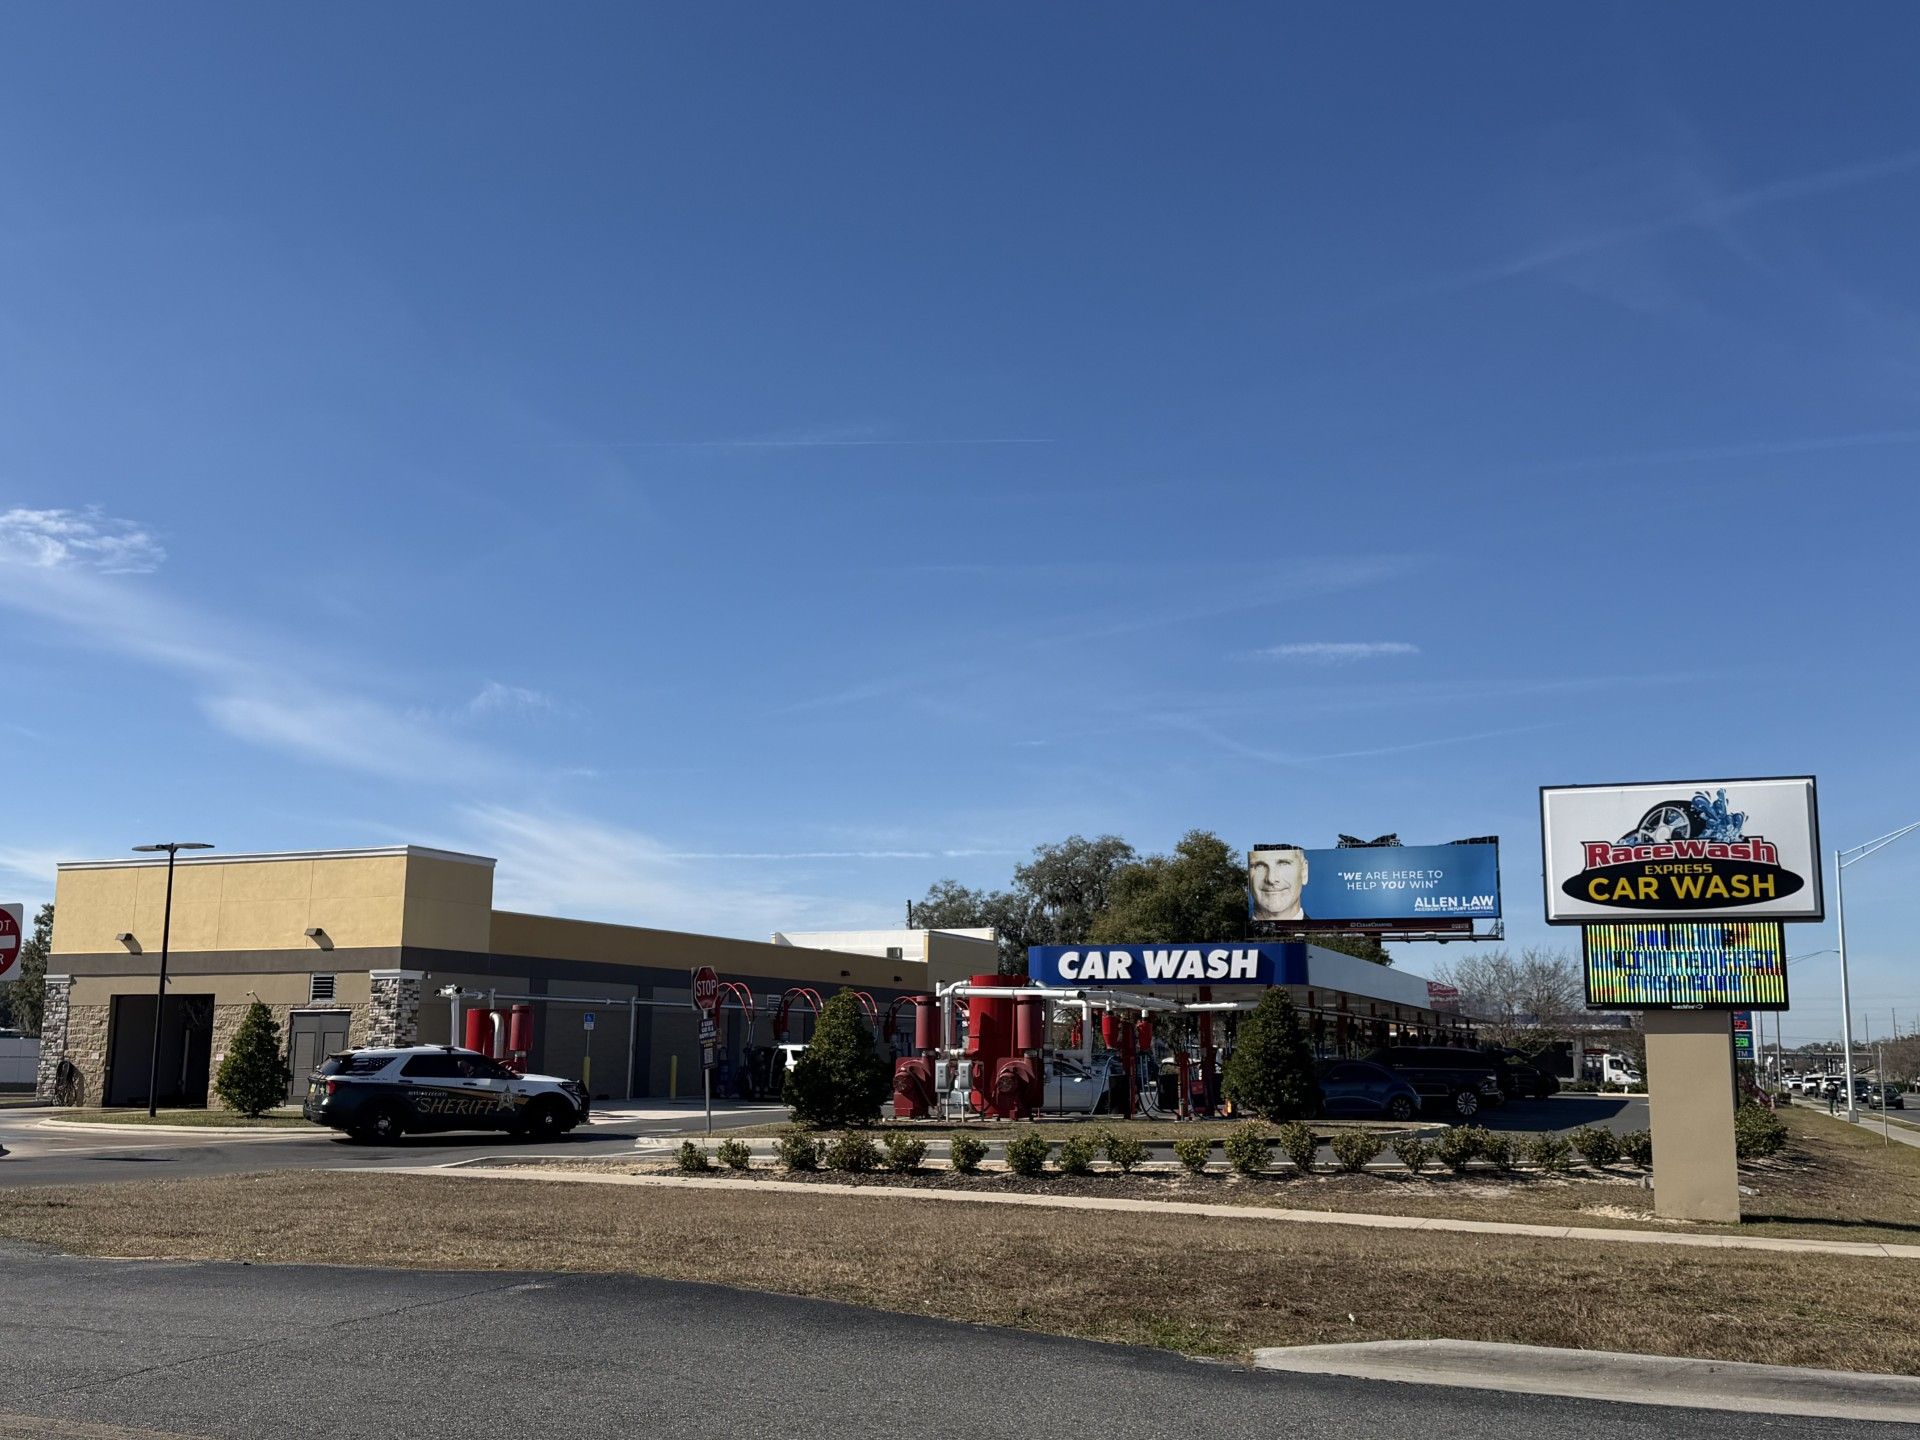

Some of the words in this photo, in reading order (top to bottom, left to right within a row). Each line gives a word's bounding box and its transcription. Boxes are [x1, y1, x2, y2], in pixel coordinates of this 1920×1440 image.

[1585, 837, 1778, 870] RaceWash
[1365, 871, 1388, 880] ARE
[1392, 870, 1423, 879] HERE
[1428, 870, 1443, 879] TO
[1645, 863, 1713, 875] EXPRESS
[1347, 881, 1376, 890] HELP
[1381, 881, 1405, 889] YOU
[1588, 876, 1660, 900] CAR
[1671, 874, 1775, 899] WASH
[1414, 896, 1458, 907] ALLEN
[1462, 895, 1494, 906] LAW
[1057, 951, 1133, 980] CAR
[1142, 949, 1259, 979] WASH
[696, 980, 717, 996] STOP
[416, 1097, 498, 1115] SHERIFF
